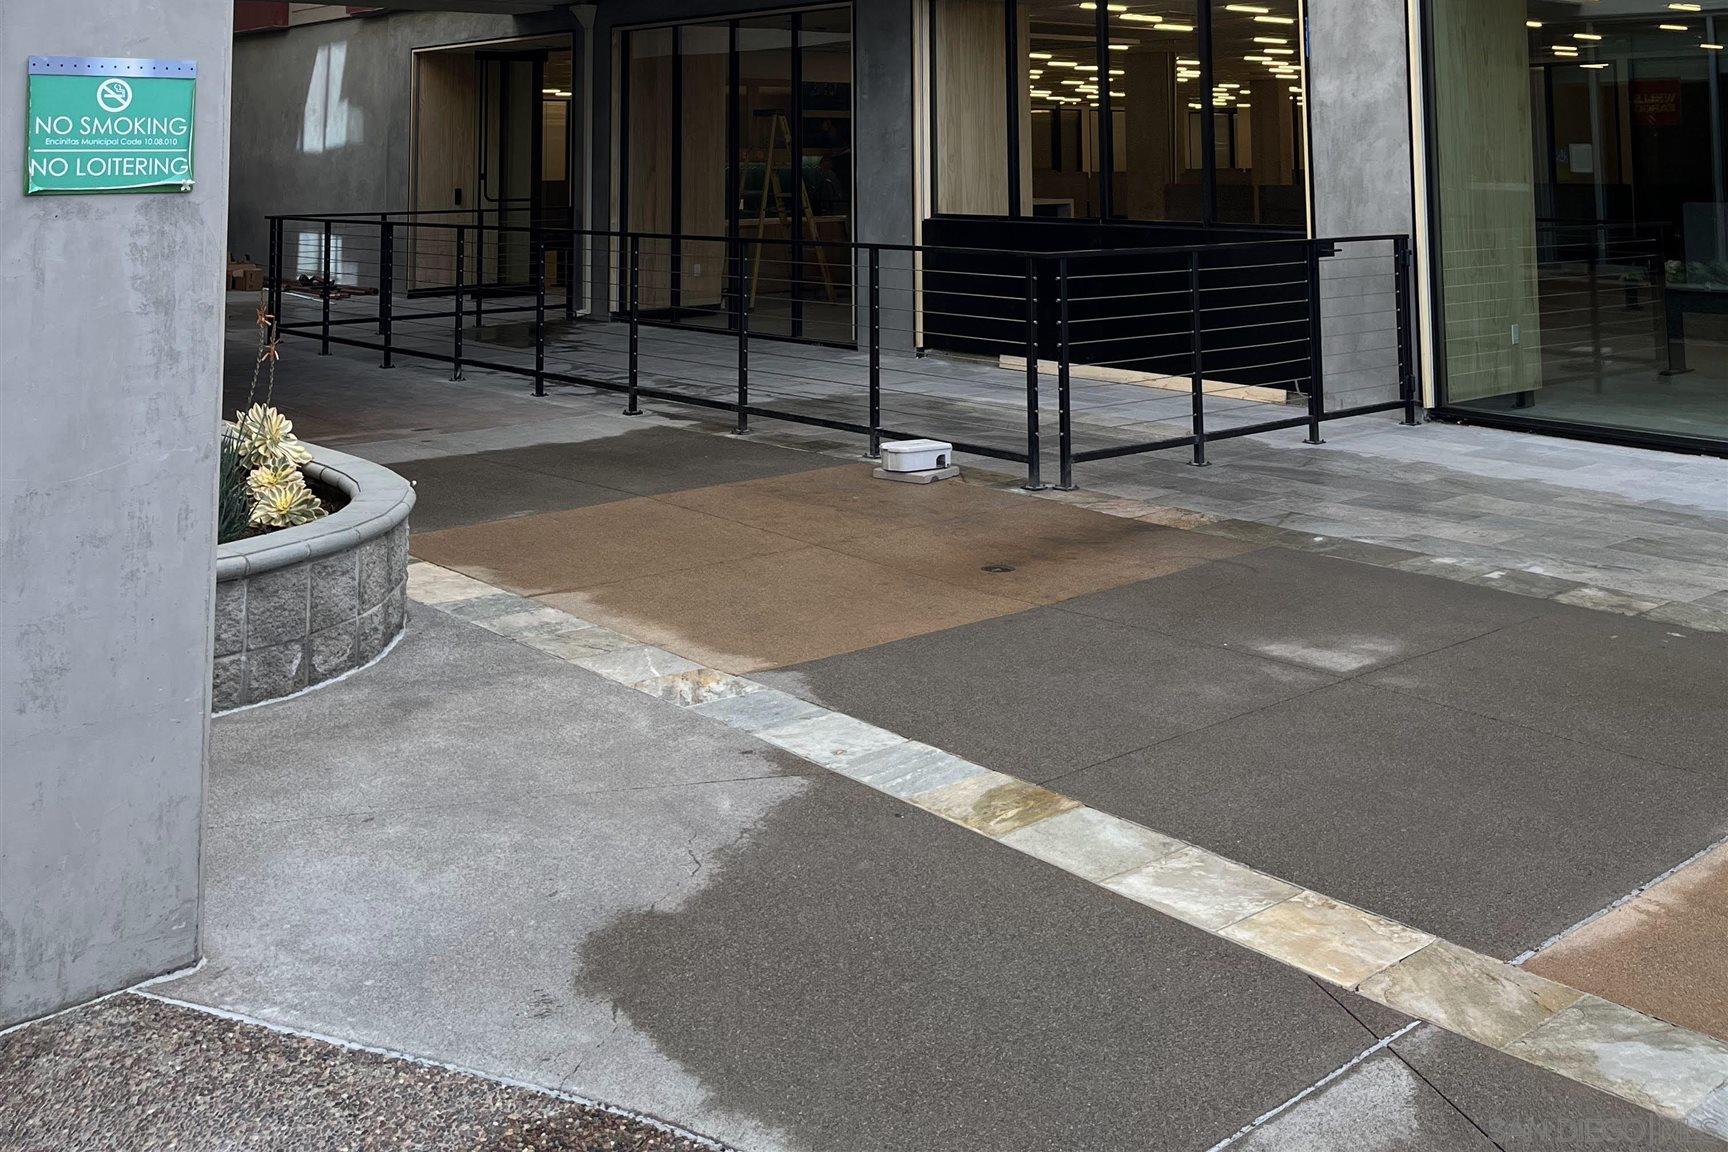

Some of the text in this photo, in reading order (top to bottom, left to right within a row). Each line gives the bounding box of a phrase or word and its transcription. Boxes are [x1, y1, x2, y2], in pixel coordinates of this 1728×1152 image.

[35, 116, 187, 135] NO SMOKING
[45, 137, 178, 146] Encinitas Municipal Code 10.08.010
[30, 157, 188, 177] NO LOITERING
